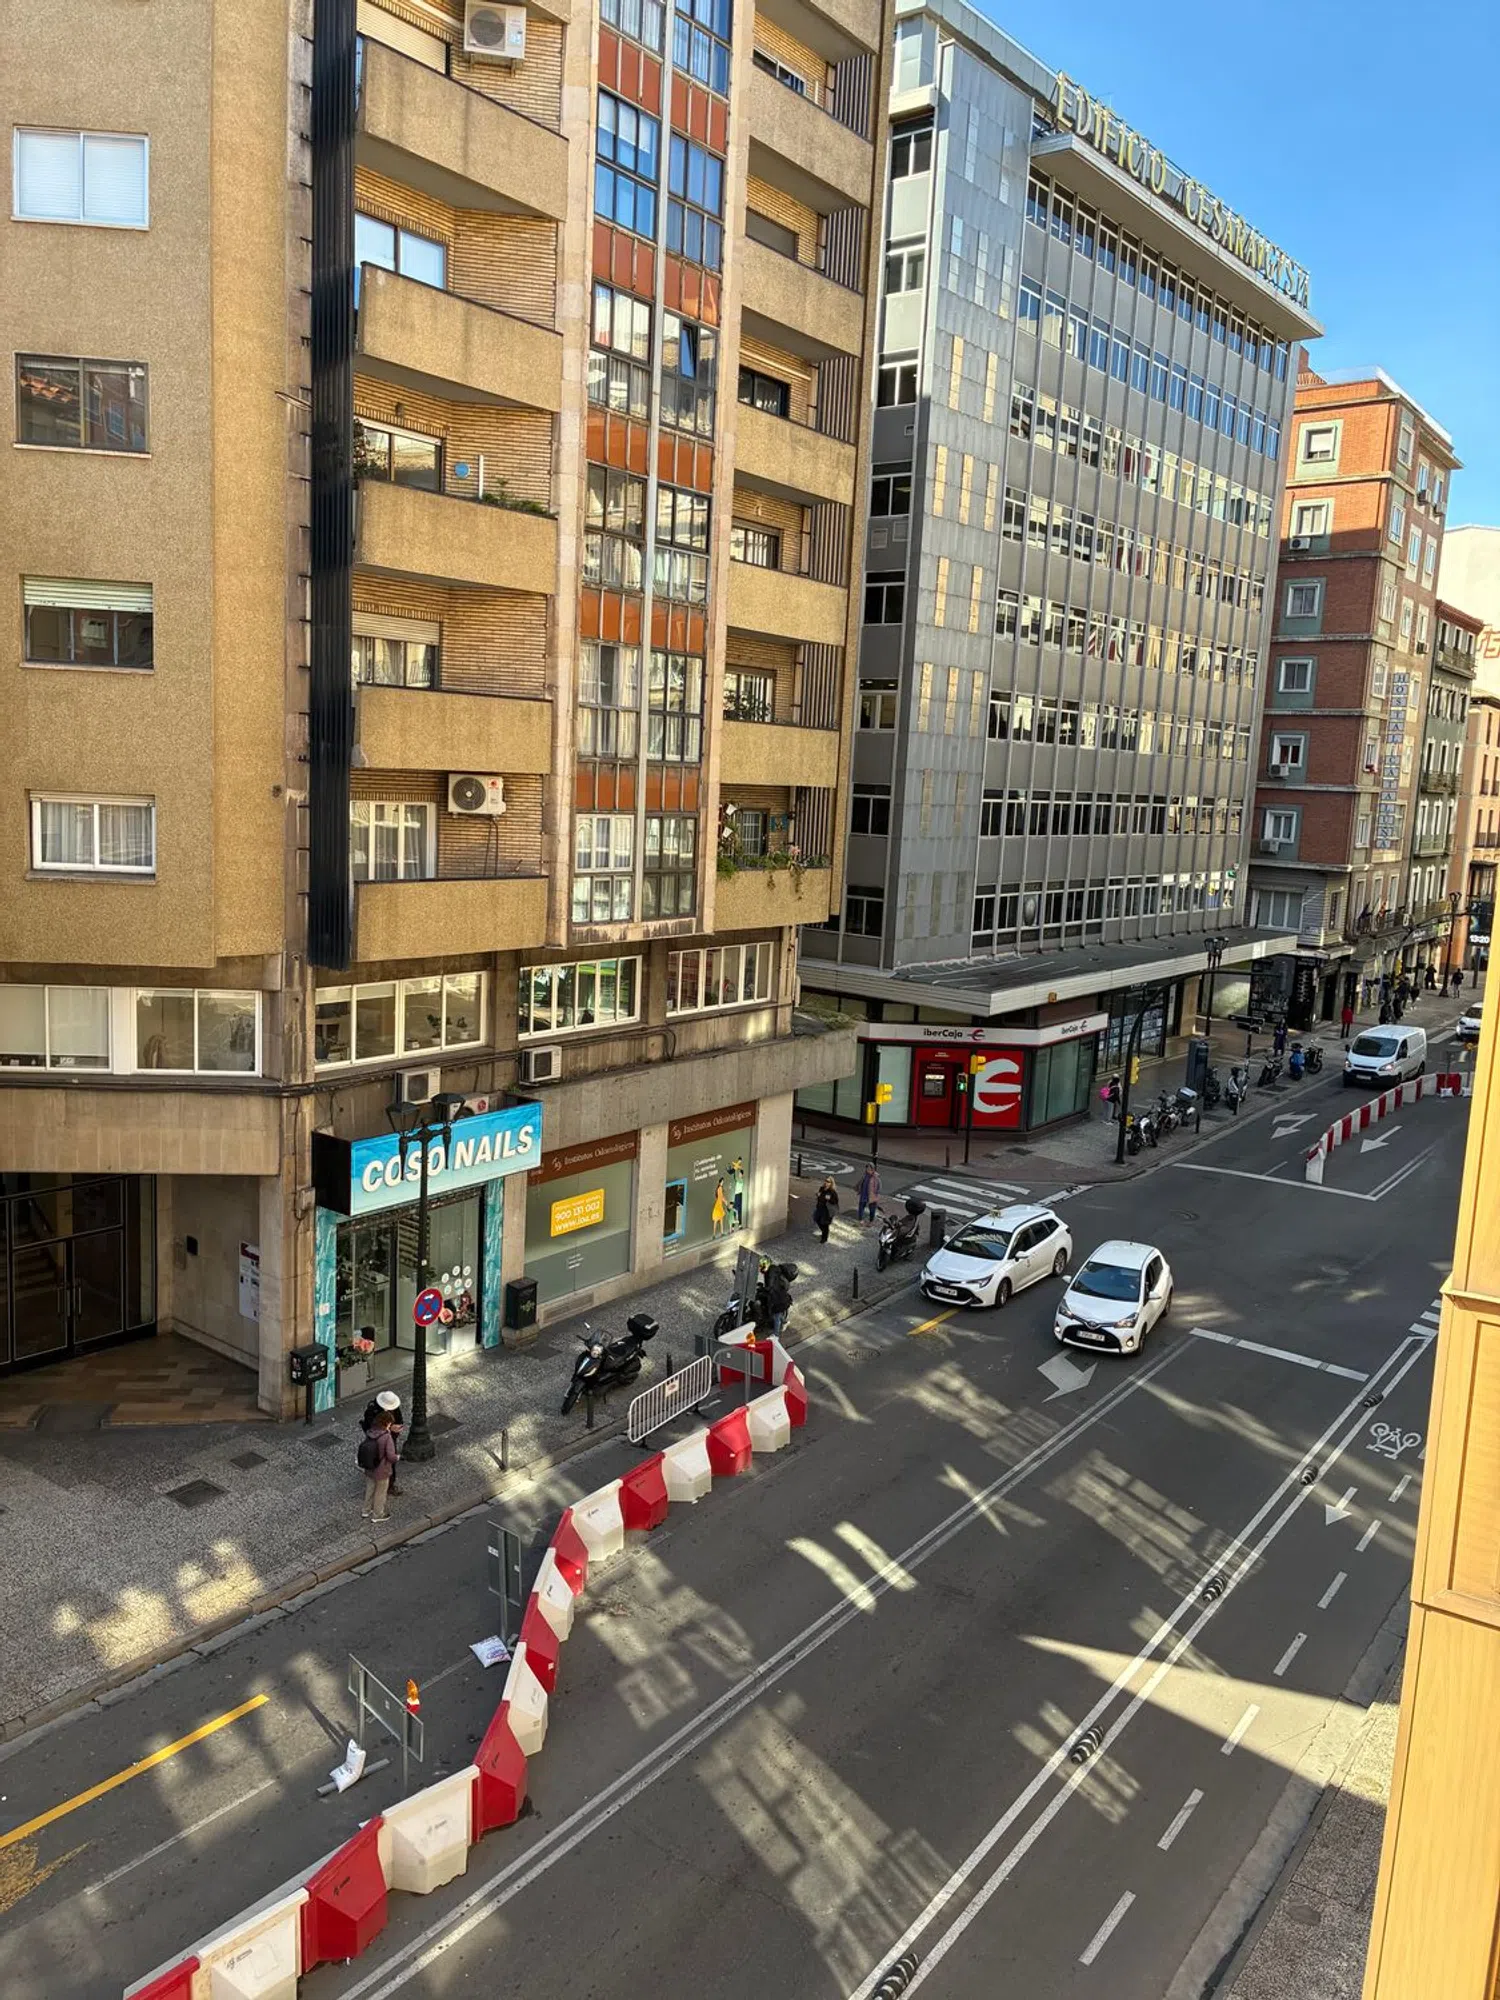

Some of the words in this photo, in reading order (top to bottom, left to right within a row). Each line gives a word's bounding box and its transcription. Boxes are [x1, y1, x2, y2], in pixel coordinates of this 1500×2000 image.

[1057, 71, 1167, 195] EDIFICIO
[362, 1145, 446, 1192] COSO
[453, 1125, 534, 1170] NAILS
